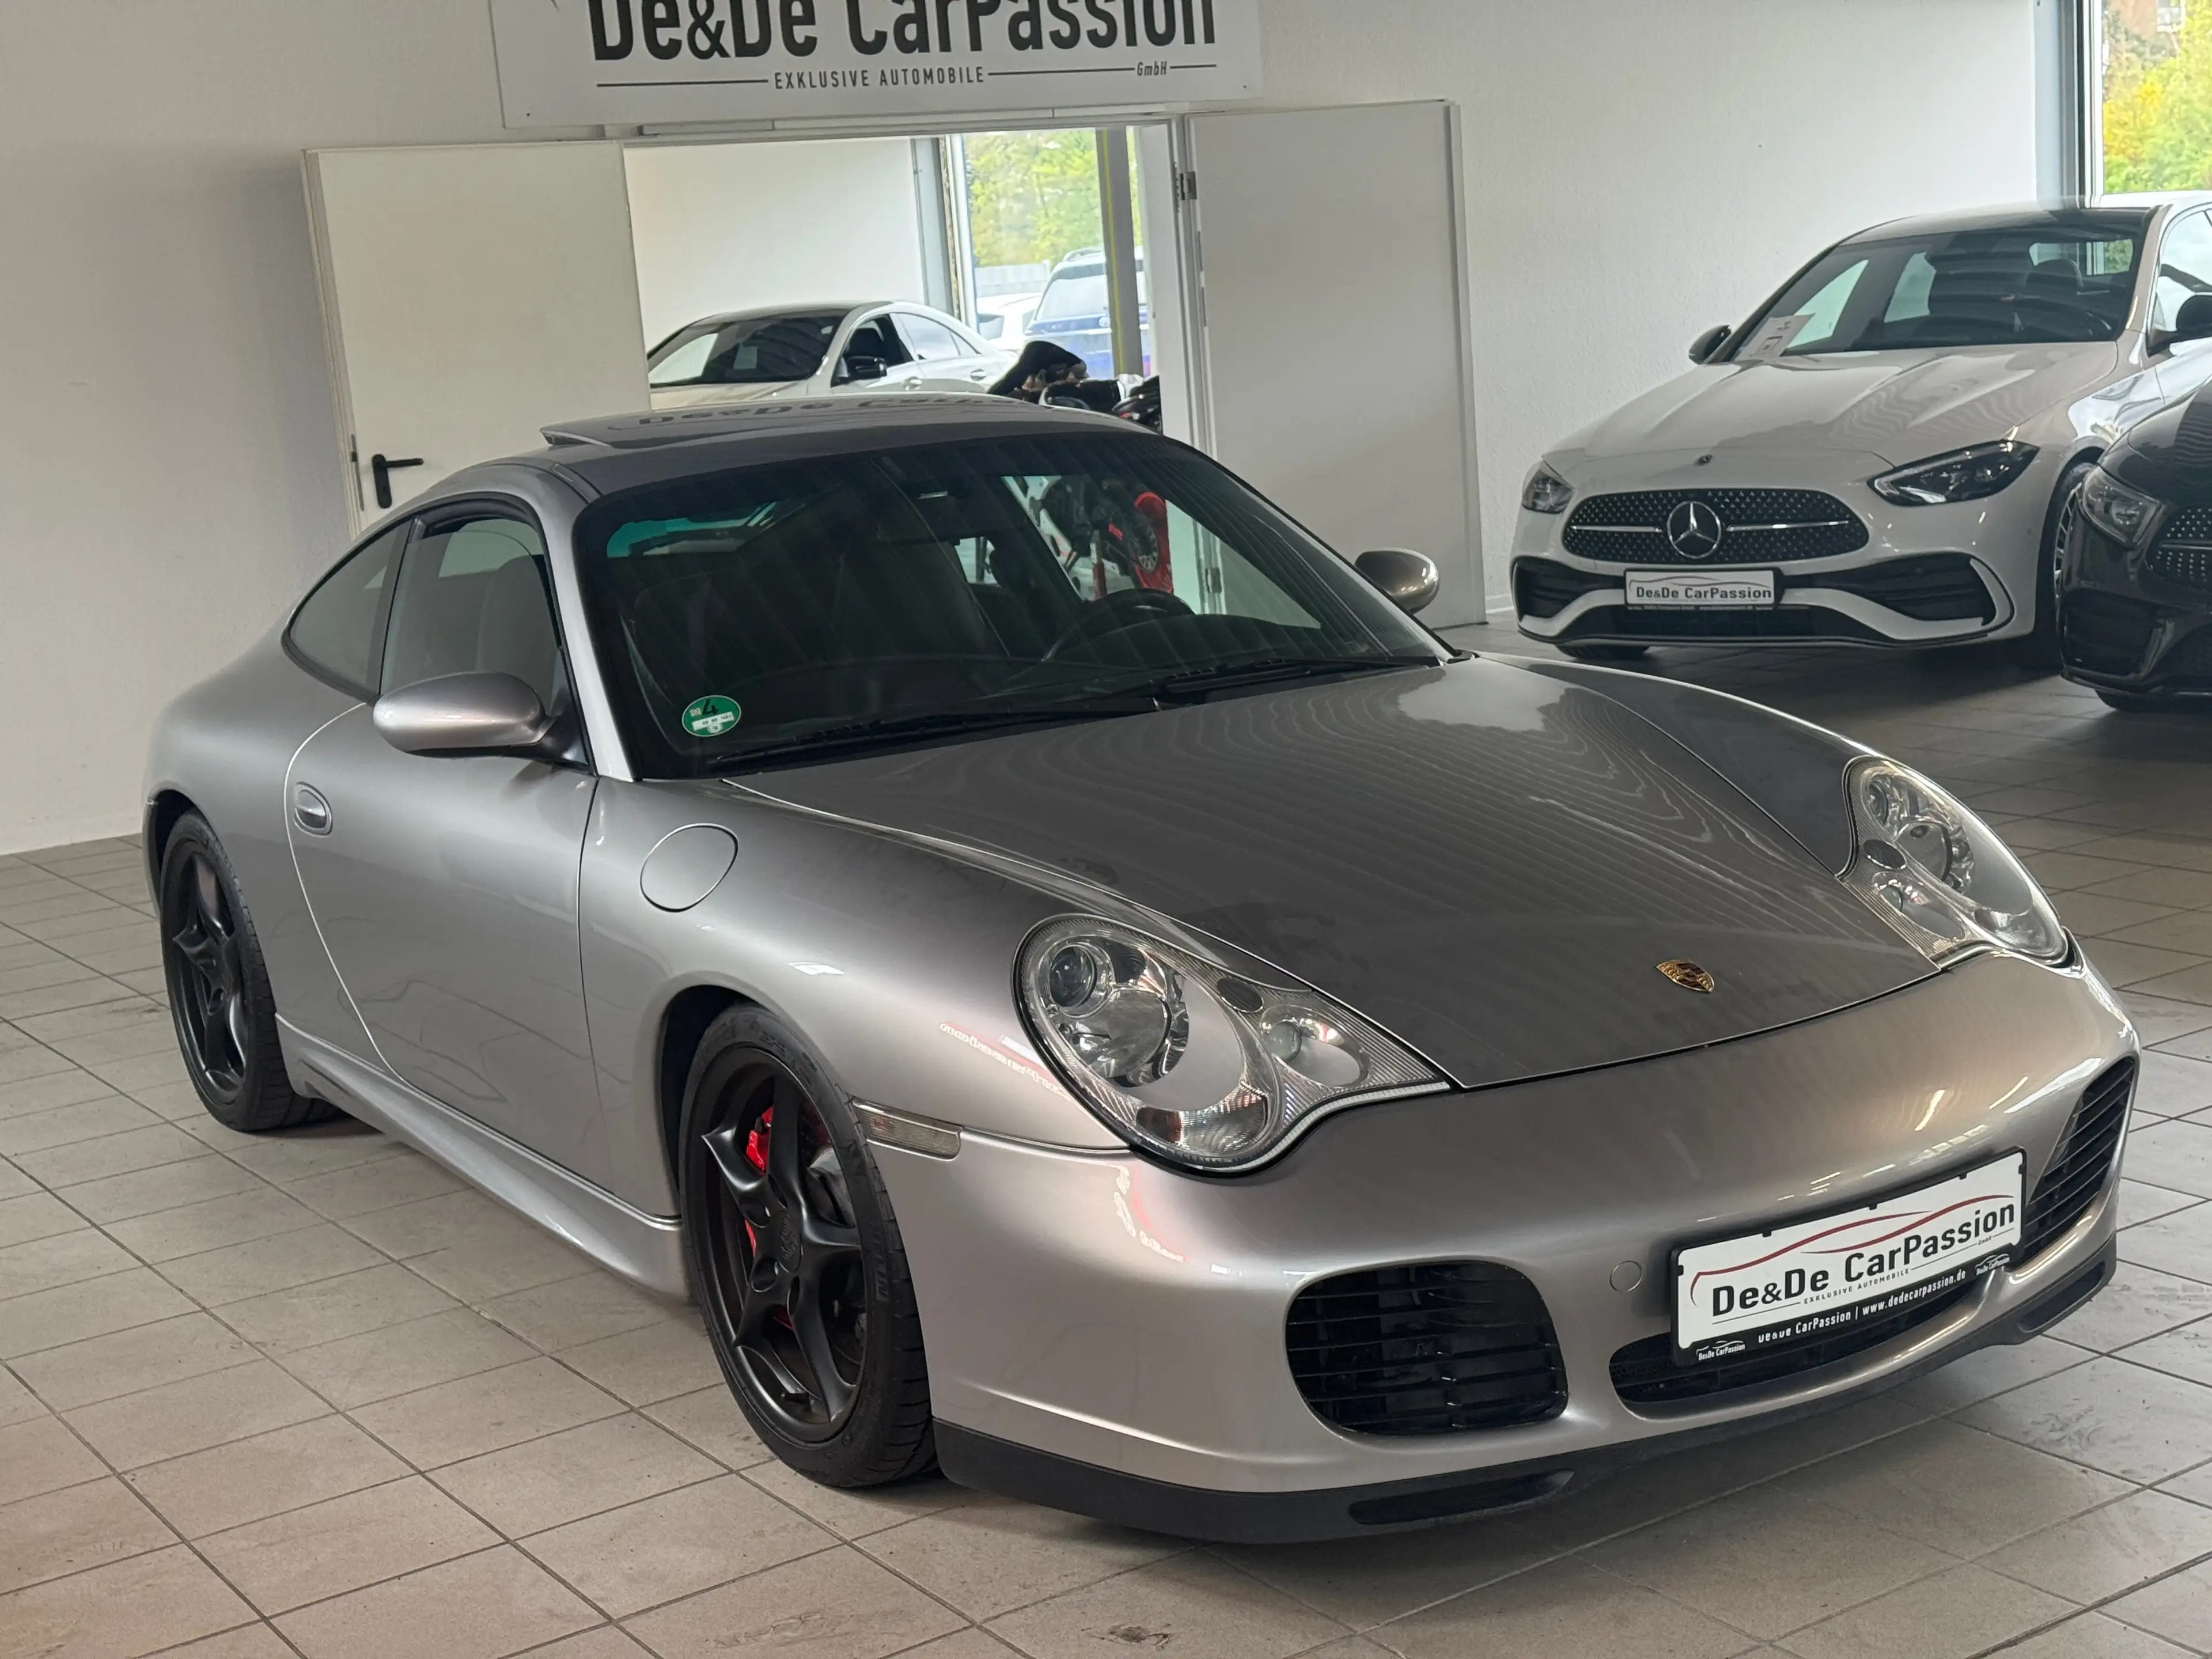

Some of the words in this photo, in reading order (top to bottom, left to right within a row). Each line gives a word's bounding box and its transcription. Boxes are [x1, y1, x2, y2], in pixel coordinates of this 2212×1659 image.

[588, 0, 818, 60] De&De
[847, 0, 1216, 56] CarPassion
[774, 70, 870, 90] EXKLUSIVE
[879, 66, 984, 86] AUTOMOBILE
[1137, 60, 1167, 77] GmbH
[1636, 586, 1679, 599] De&De
[1684, 586, 1772, 599] CarPassion
[1712, 1268, 1830, 1317] De&De
[1844, 1203, 2014, 1282] CarPassion
[1795, 1311, 1851, 1334] CarPassion
[1862, 1268, 1967, 1316] www.dedecarpassion.de
[1804, 1286, 1853, 1305] EXKLUSIVE
[1857, 1268, 1910, 1290] AUTOMOBILE
